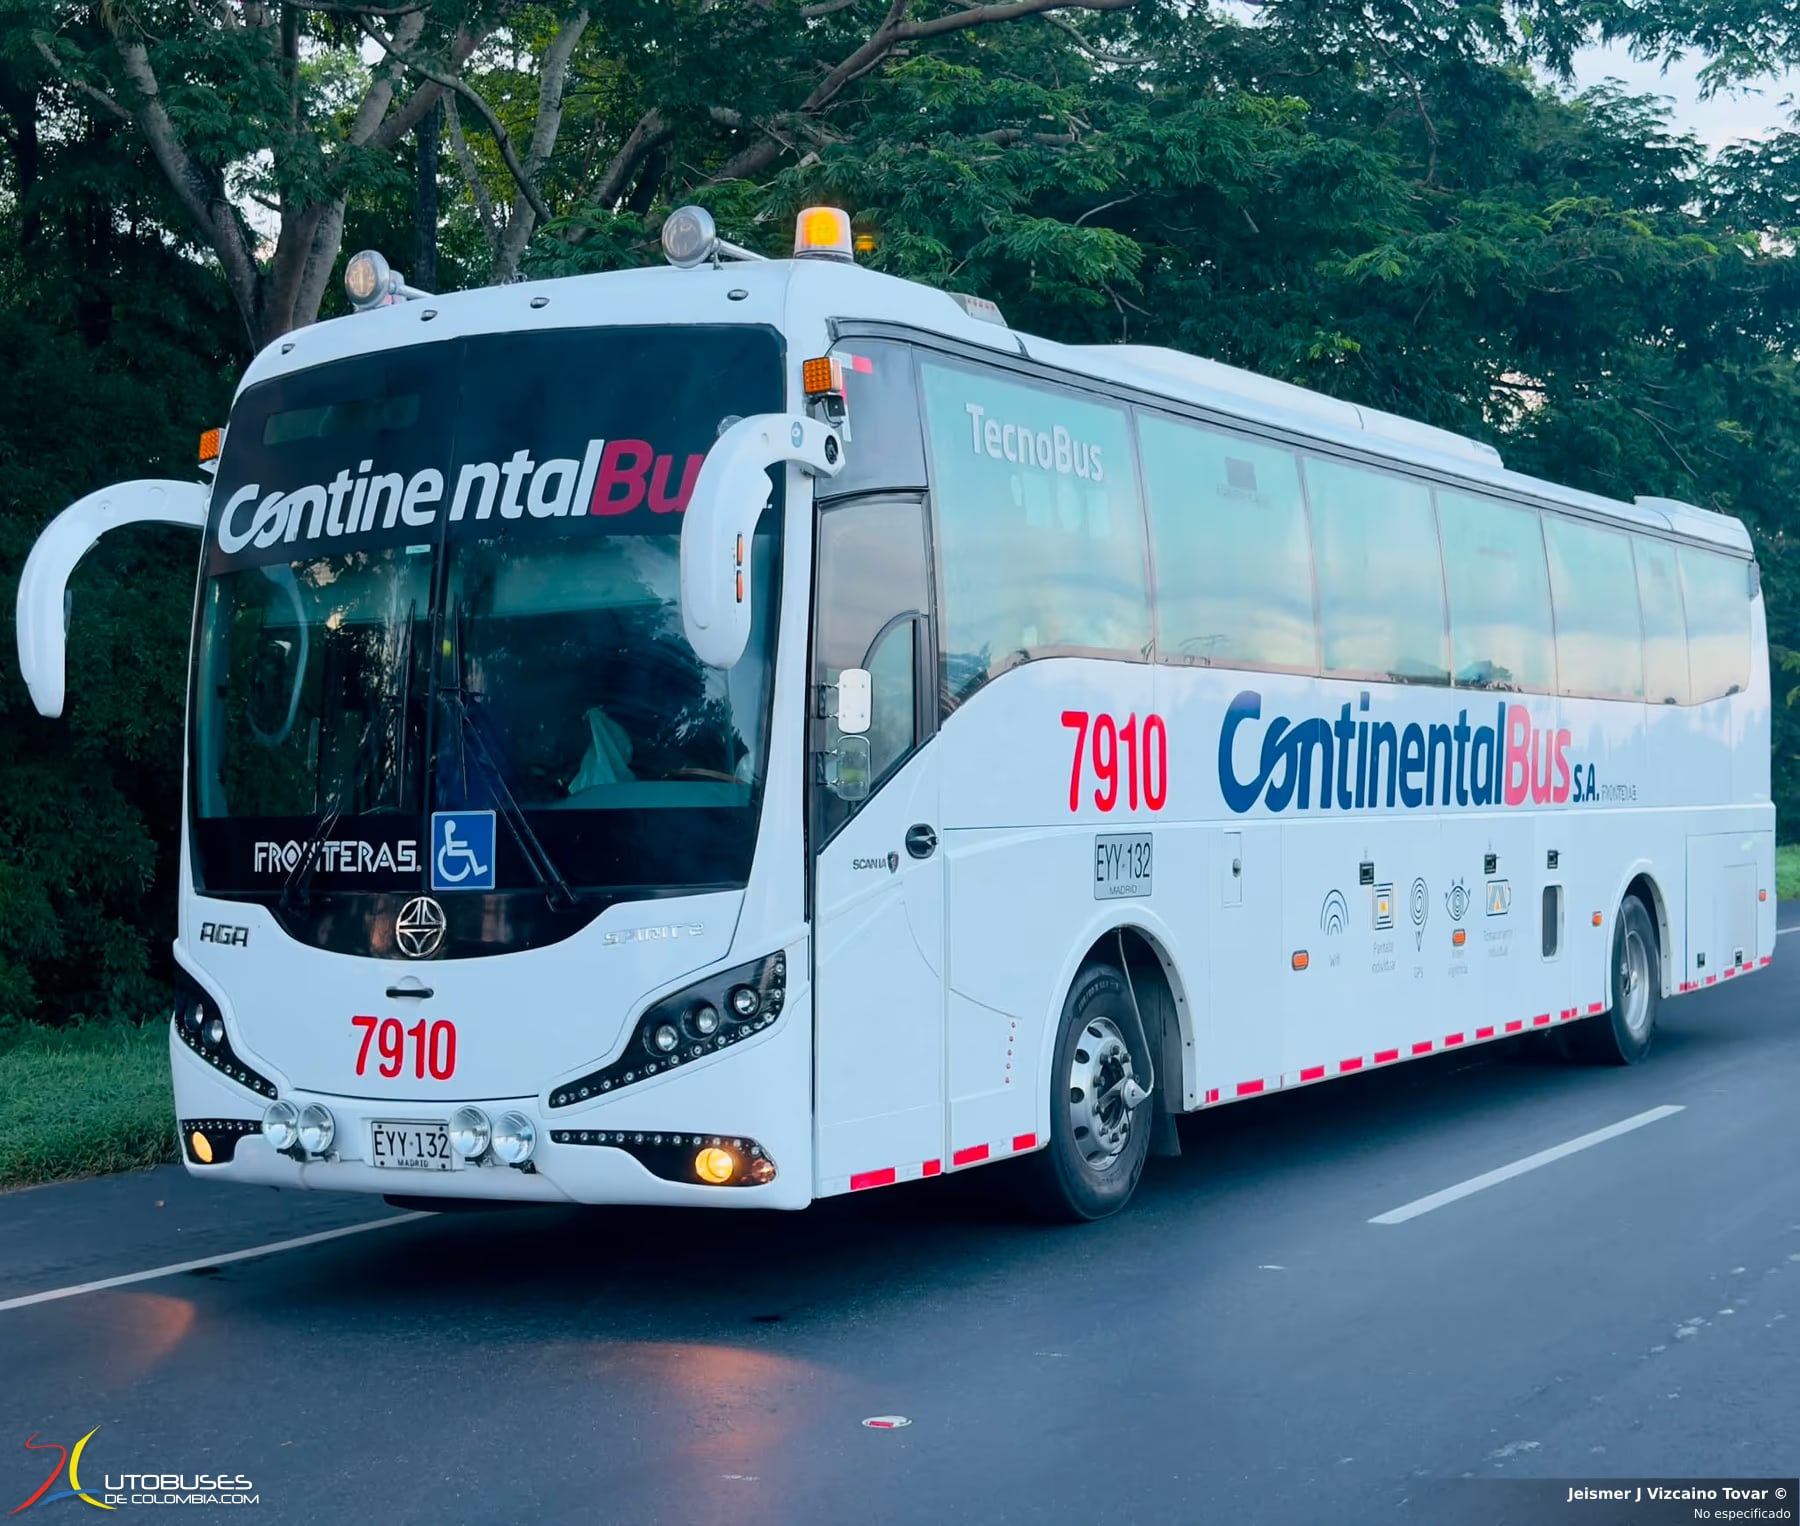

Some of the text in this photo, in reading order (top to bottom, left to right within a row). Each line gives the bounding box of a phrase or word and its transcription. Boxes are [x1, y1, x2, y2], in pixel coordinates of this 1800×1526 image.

[965, 402, 1104, 481] TecnoBus
[218, 439, 705, 554] ContinentalBu
[1061, 710, 1167, 812] 7910
[1573, 763, 1599, 802] S.A.
[852, 858, 887, 870] SCANIA
[1108, 884, 1138, 895] MADRID
[199, 921, 250, 948] AGA
[351, 1015, 457, 1081] 7910
[397, 1159, 429, 1168] MADRID
